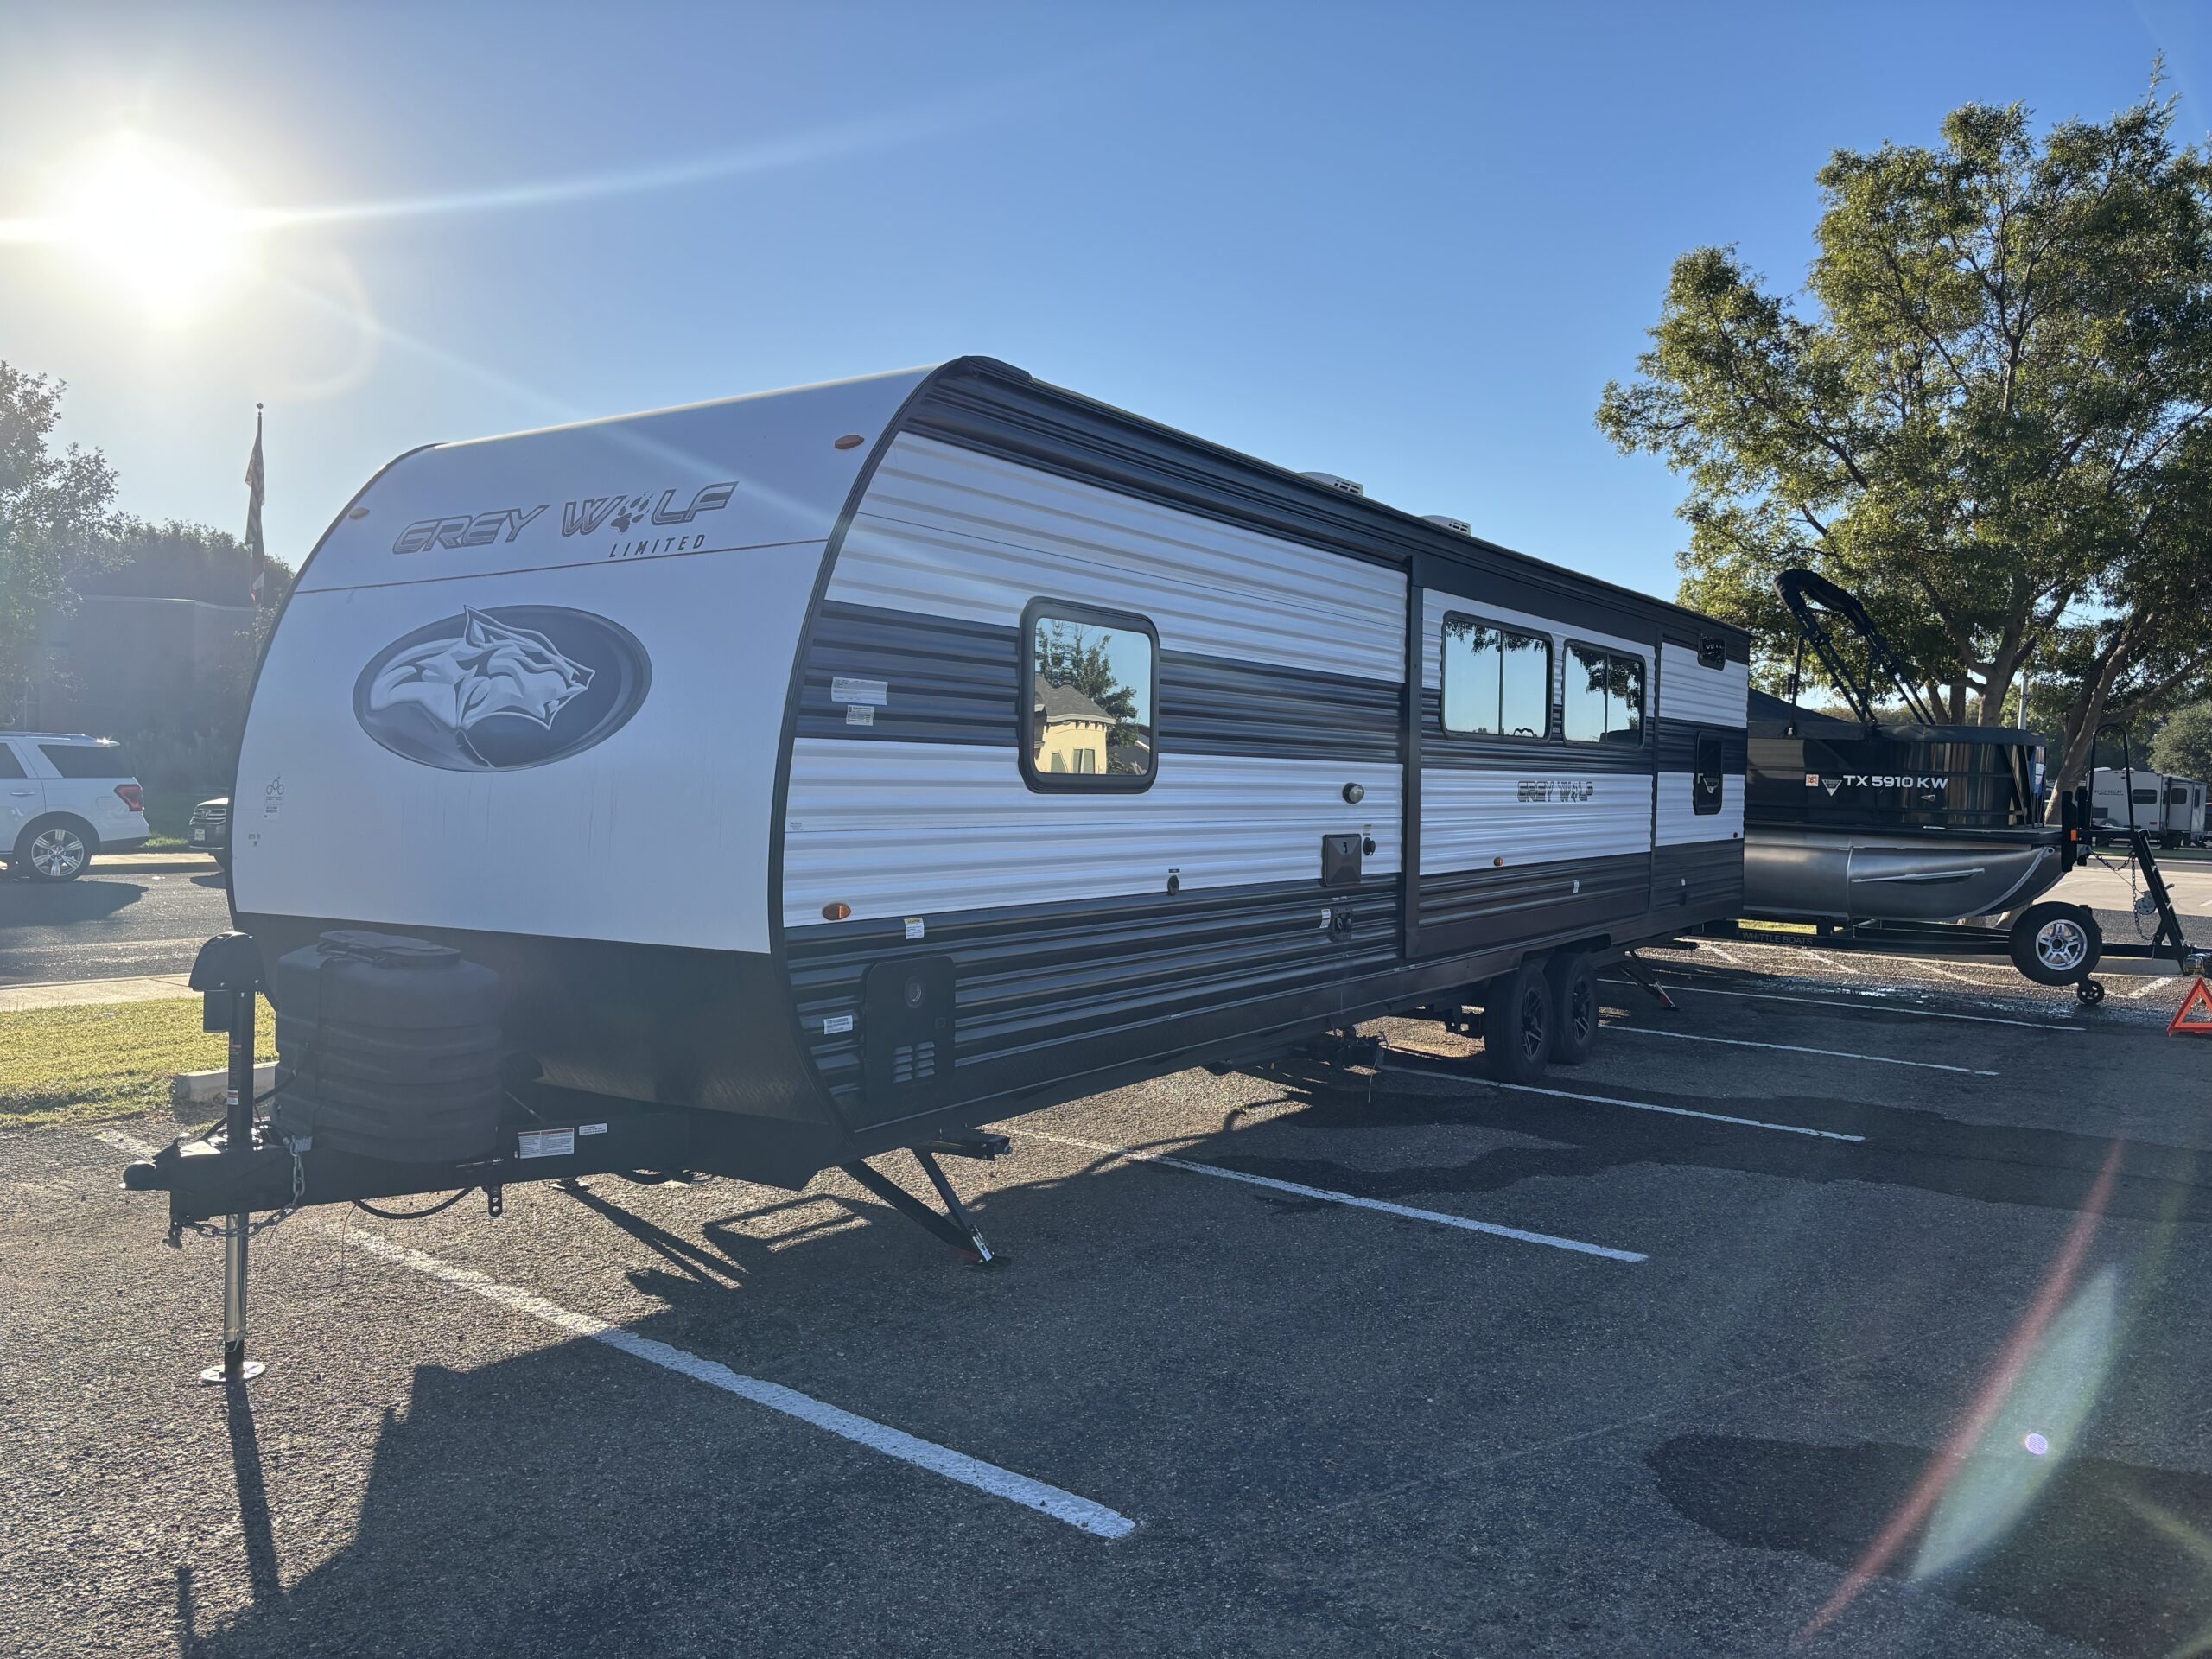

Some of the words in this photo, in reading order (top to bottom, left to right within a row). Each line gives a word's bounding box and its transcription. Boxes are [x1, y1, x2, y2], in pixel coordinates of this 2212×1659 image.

[392, 504, 551, 555] GREY
[608, 534, 706, 559] LIMITED
[1517, 780, 1554, 802] GREY
[1843, 775, 1868, 786] TX
[1872, 776, 1913, 787] 5910
[1916, 777, 1948, 789] KW
[1742, 932, 1780, 943] WHITTLE
[1783, 936, 1813, 944] BOATS
